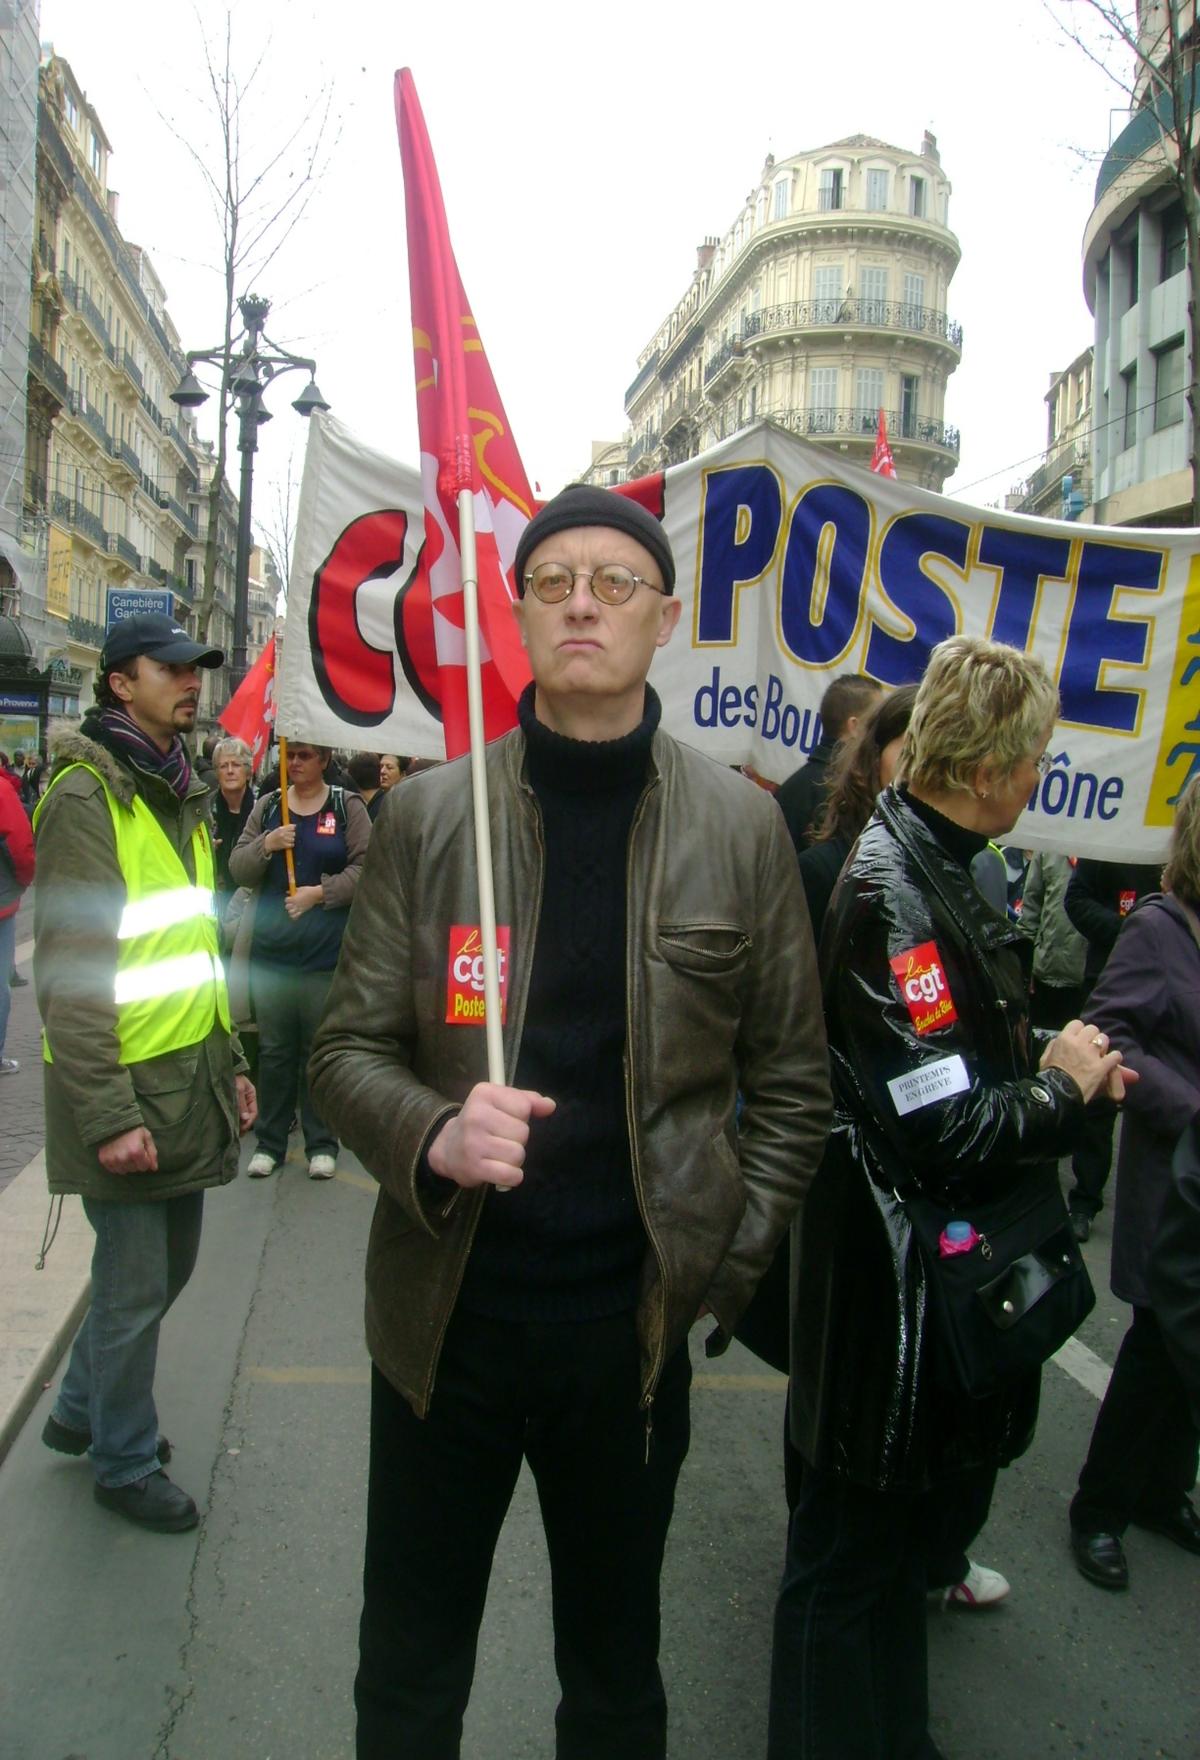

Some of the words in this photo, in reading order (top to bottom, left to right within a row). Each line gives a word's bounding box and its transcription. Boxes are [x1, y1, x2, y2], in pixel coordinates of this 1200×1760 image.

[111, 596, 164, 609] Canebière
[691, 459, 1171, 738] POSTE
[3, 698, 39, 708] Provence
[694, 666, 759, 728] des
[761, 674, 823, 755] Bou
[1028, 751, 1124, 820] ône
[453, 948, 505, 991] cgt
[905, 963, 944, 1003] cgt
